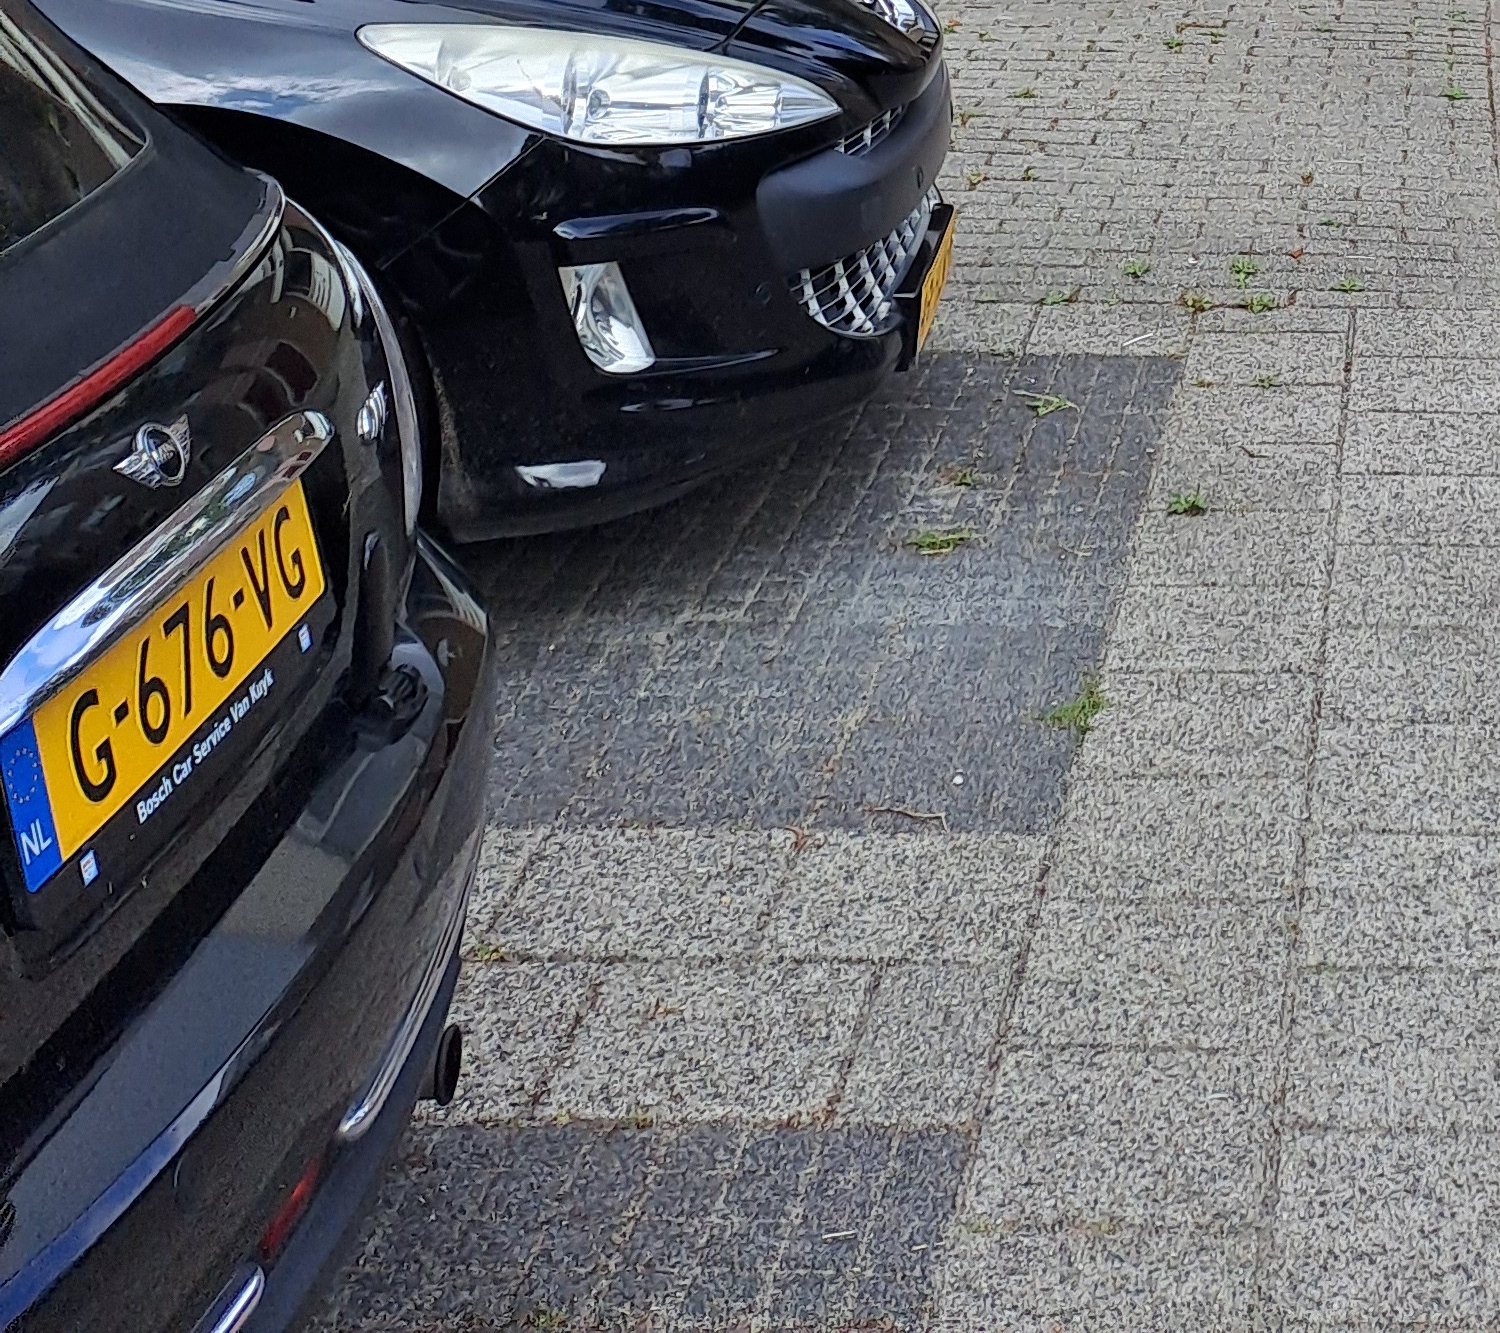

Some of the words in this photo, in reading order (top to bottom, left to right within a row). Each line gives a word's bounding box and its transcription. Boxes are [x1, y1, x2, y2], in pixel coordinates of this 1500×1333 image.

[68, 506, 306, 804] G-676-VG
[136, 775, 173, 824] Bosch
[172, 756, 193, 785] Car
[192, 716, 232, 764] Service
[229, 696, 250, 724] Van
[249, 668, 275, 704] Kuyk
[20, 818, 53, 865] NL
